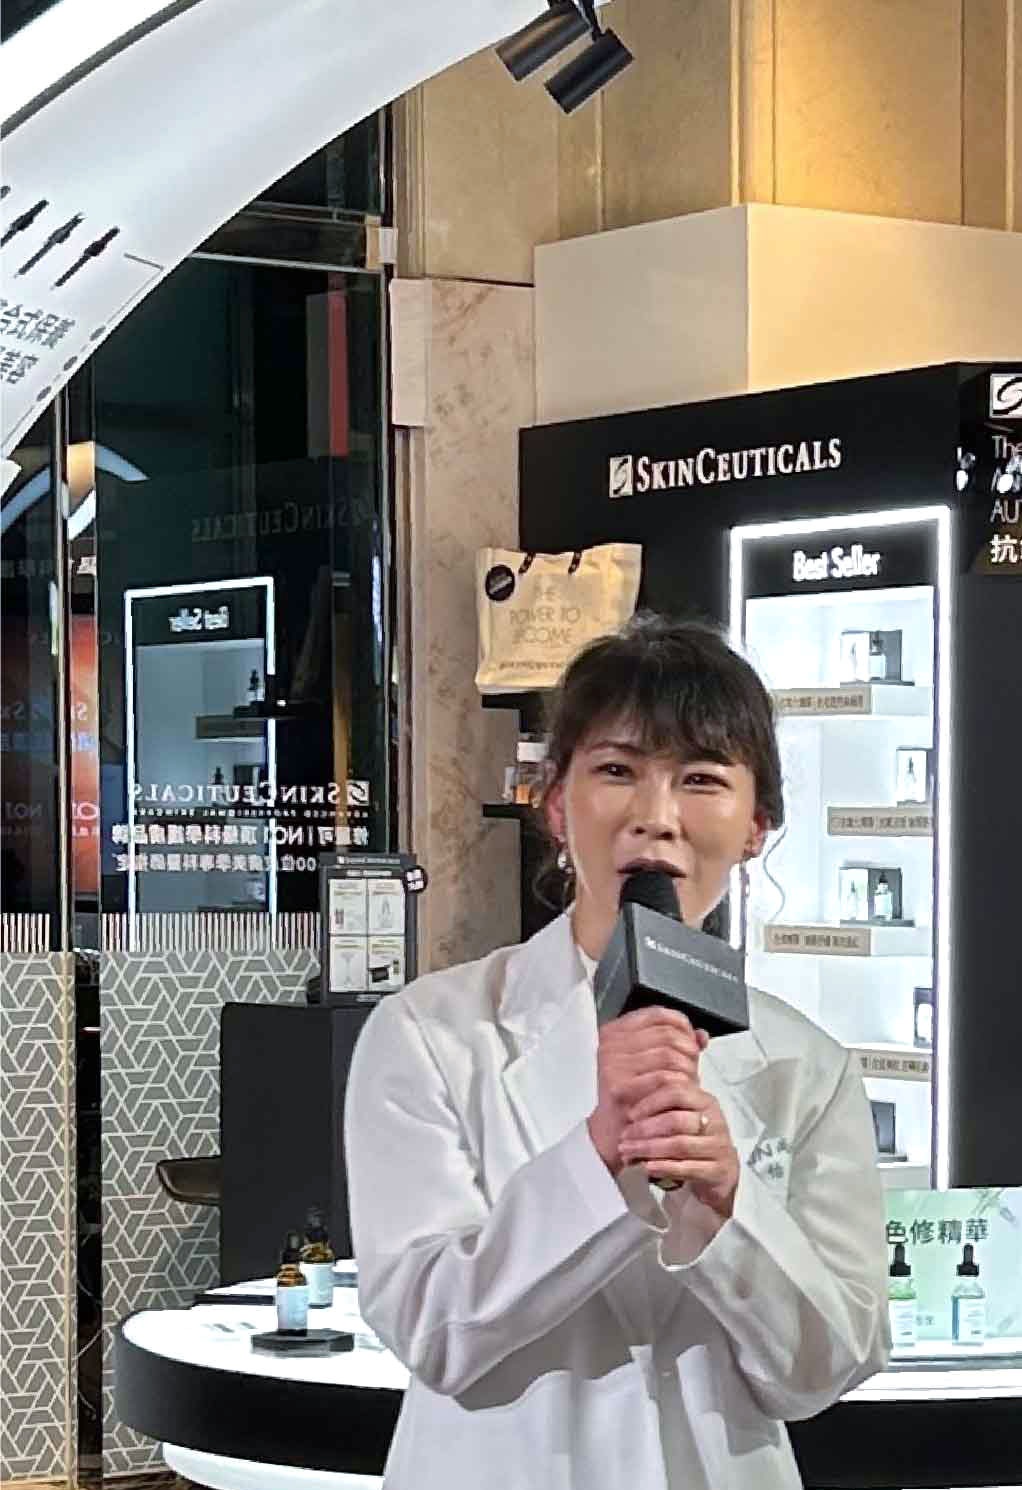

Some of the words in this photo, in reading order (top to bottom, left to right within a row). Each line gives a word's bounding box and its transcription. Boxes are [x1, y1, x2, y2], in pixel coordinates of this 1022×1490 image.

[793, 550, 828, 581] Best
[831, 544, 881, 577] Seller
[884, 1217, 990, 1246] 色修精華
